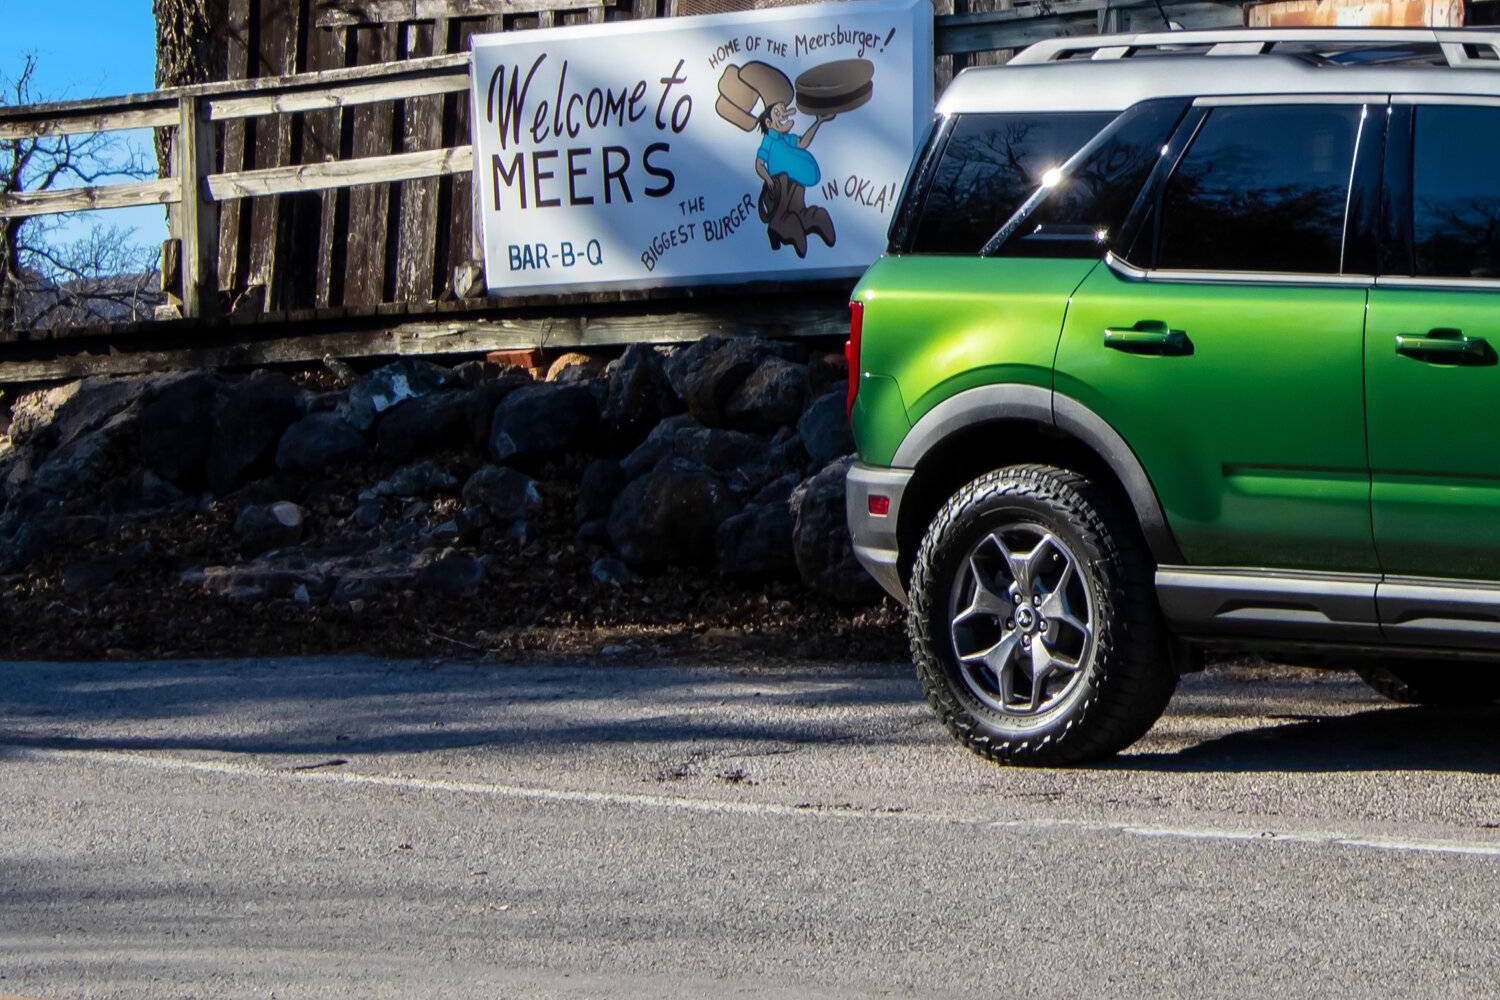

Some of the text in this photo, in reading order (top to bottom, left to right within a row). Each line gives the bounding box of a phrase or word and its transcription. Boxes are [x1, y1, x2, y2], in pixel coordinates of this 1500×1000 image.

[708, 24, 896, 69] HOME OF THE Meersburger!
[655, 58, 693, 134] to
[491, 142, 676, 212] MEERS
[821, 174, 897, 214] IN OKLA!
[679, 196, 705, 217] THE
[508, 238, 603, 272] BAR-B-Q
[640, 193, 756, 272] BIGGEST BURGER
